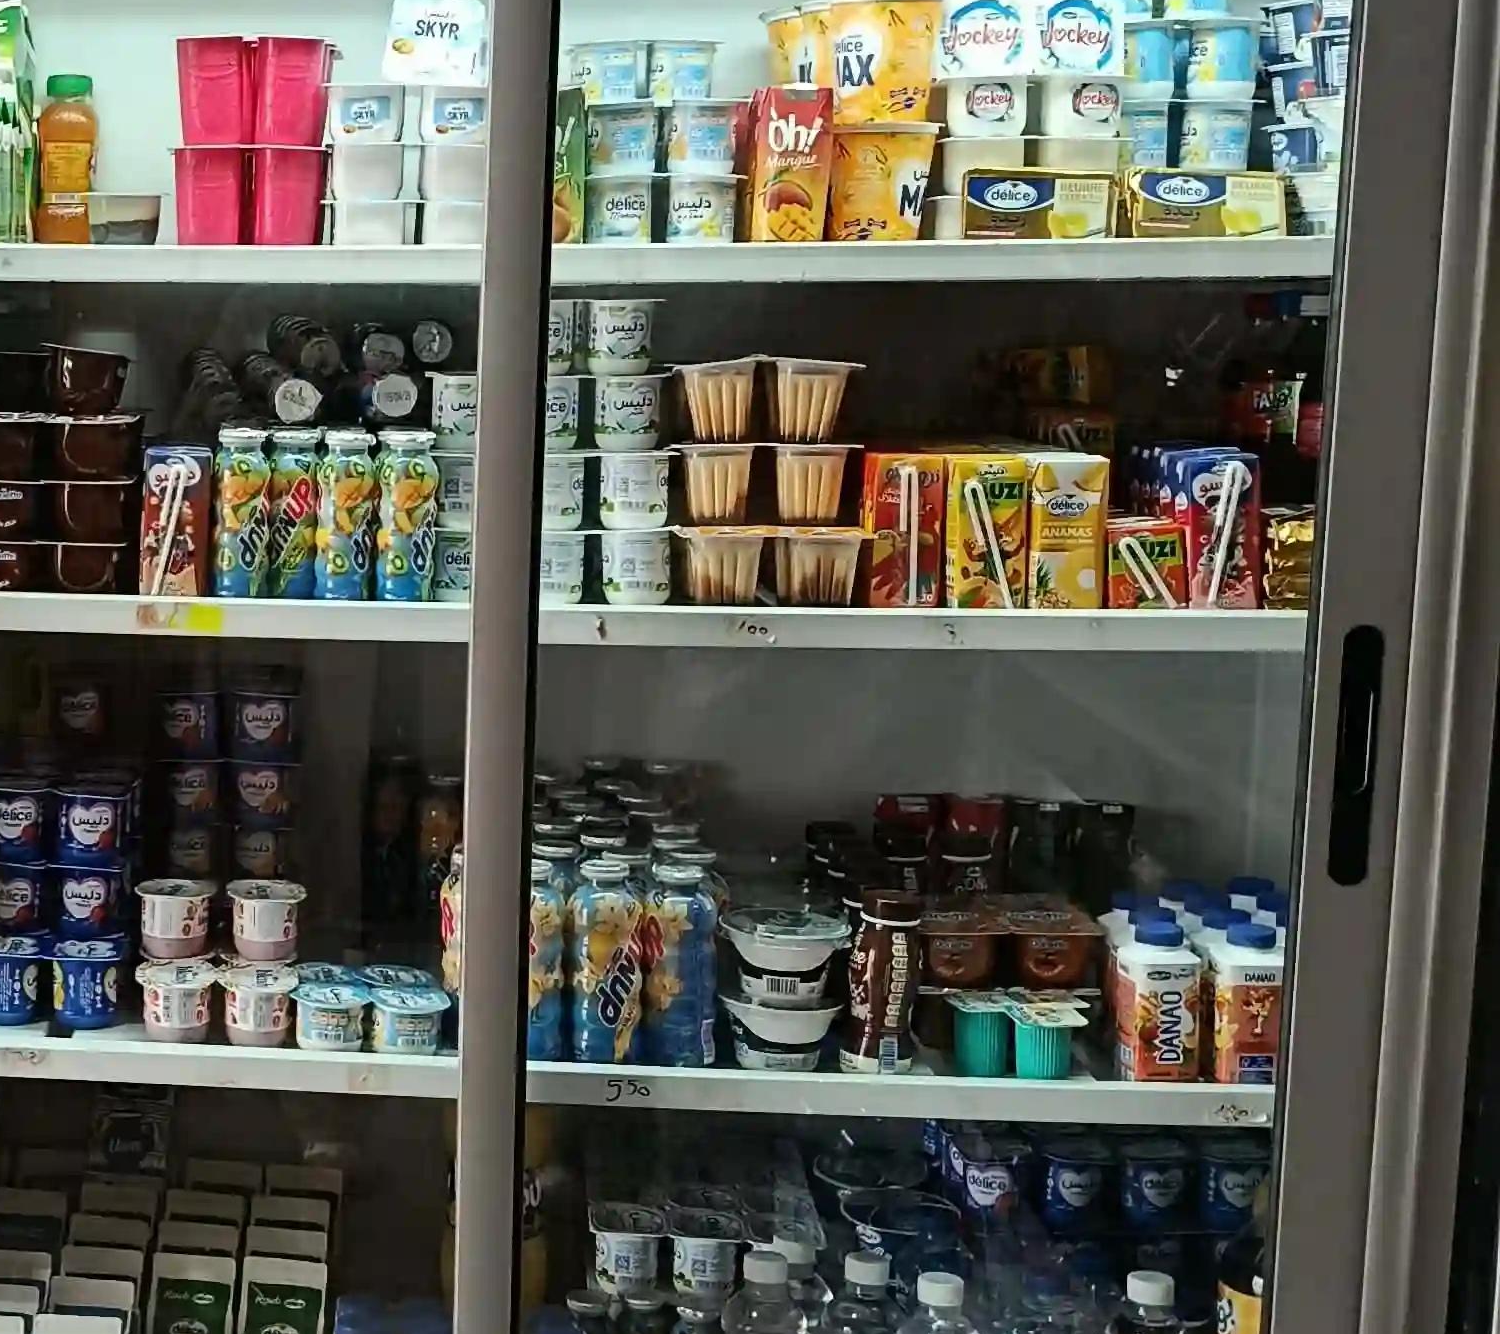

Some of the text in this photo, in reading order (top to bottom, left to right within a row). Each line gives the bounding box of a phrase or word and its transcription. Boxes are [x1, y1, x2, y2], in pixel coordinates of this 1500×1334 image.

[414, 18, 460, 41] SKYR
[990, 186, 1031, 202] délice
[1163, 180, 1204, 197] délice
[1050, 499, 1086, 513] délice
[1041, 527, 1094, 538] ANANAS
[1244, 973, 1277, 983] DANAO
[1157, 990, 1184, 1063] DANAO
